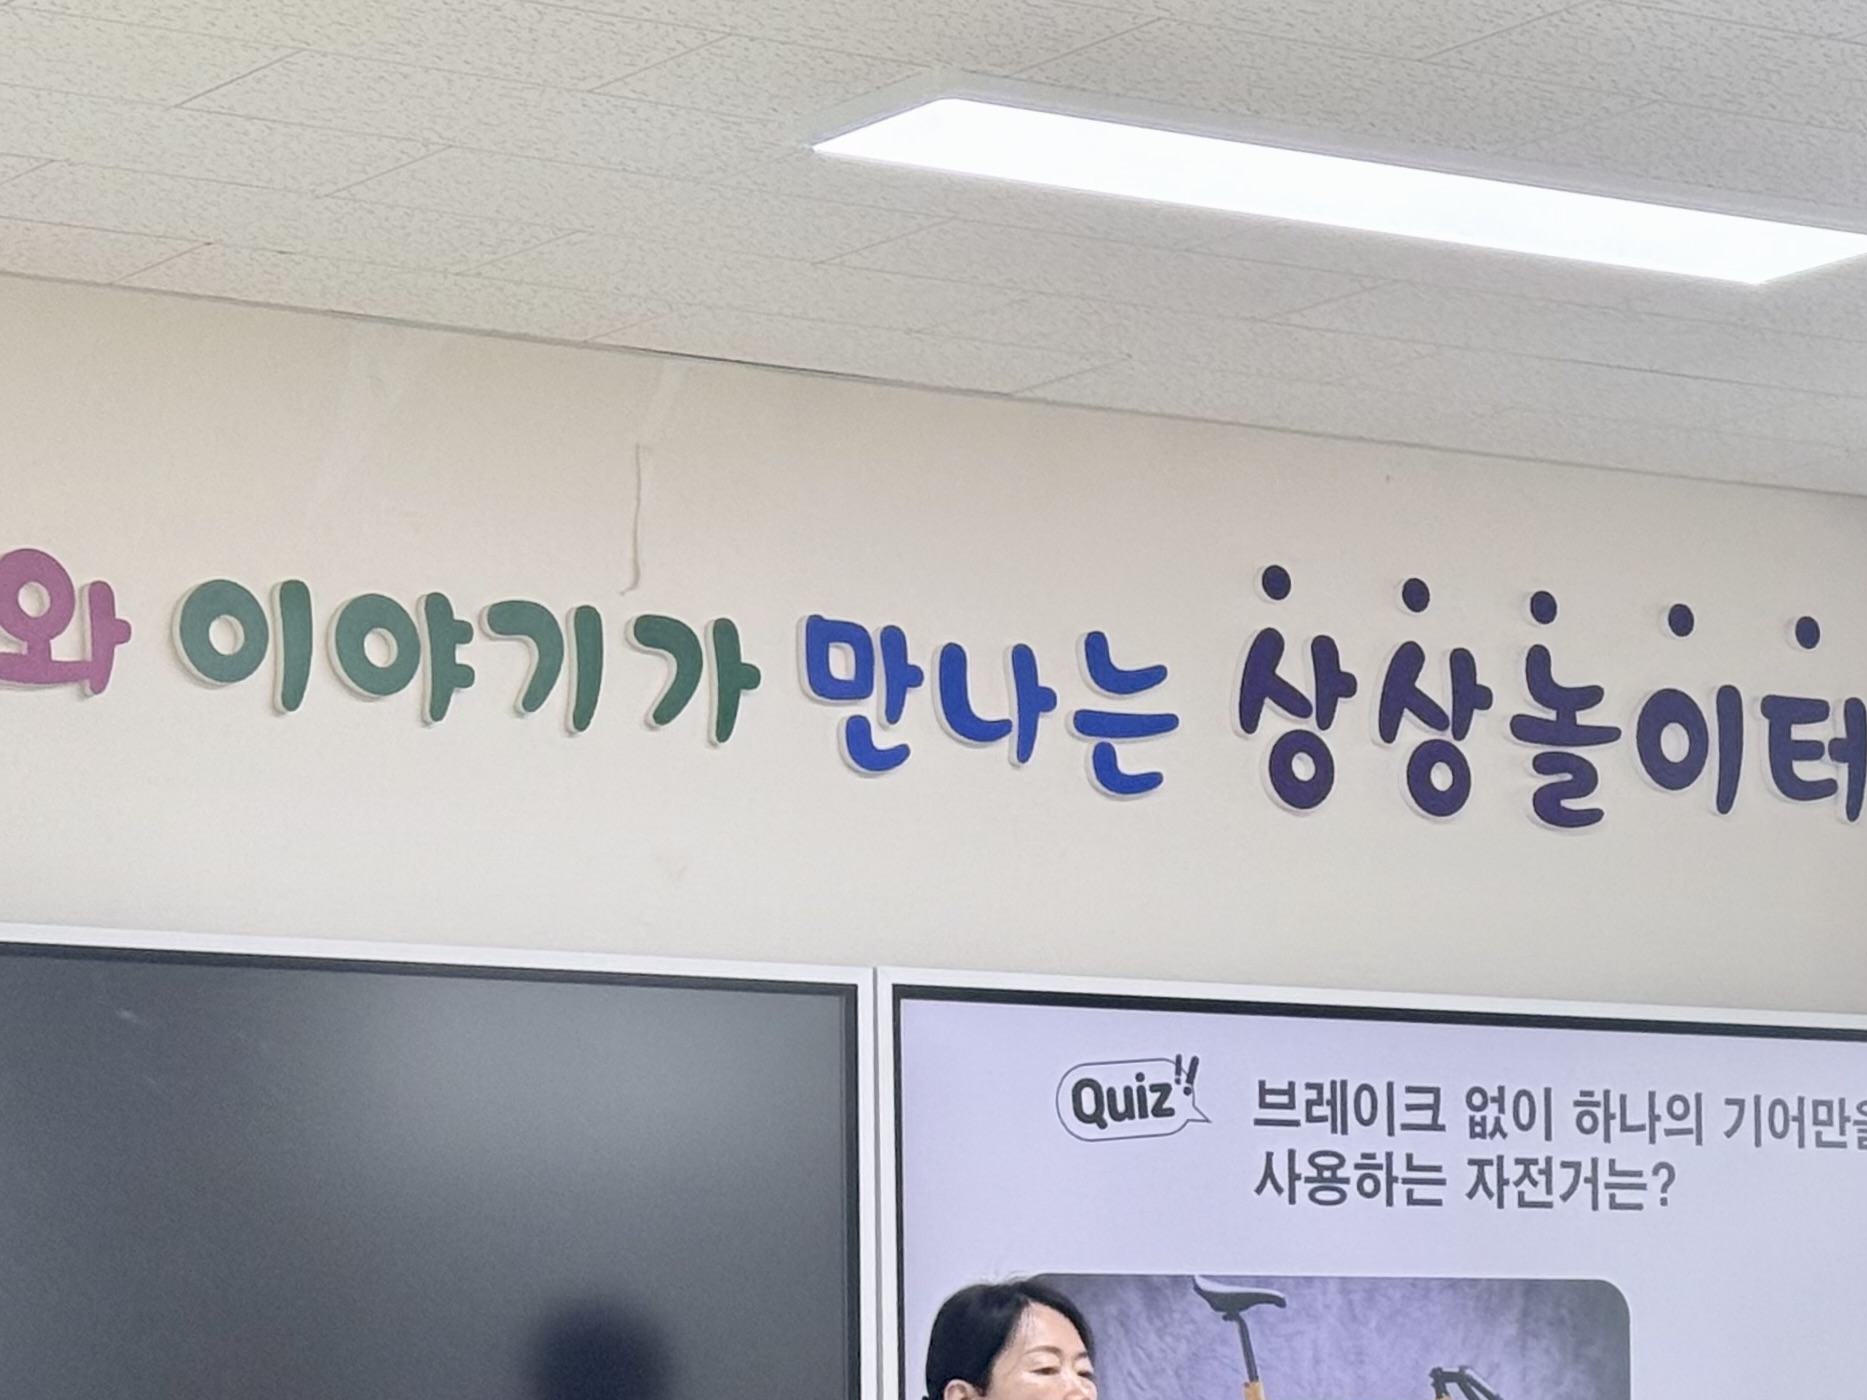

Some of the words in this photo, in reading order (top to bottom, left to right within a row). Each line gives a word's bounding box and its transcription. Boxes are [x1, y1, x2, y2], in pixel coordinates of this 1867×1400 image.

[0, 547, 132, 697] 와
[177, 577, 762, 745] 이야기가
[804, 613, 1180, 796] 만나는
[1252, 1078, 1447, 1138] 브레이크
[1464, 1085, 1553, 1142] 없이
[1572, 1088, 1704, 1147] 하나의
[1252, 1147, 1448, 1208] 사용하는
[1464, 1153, 1677, 1212] 자전거는?
